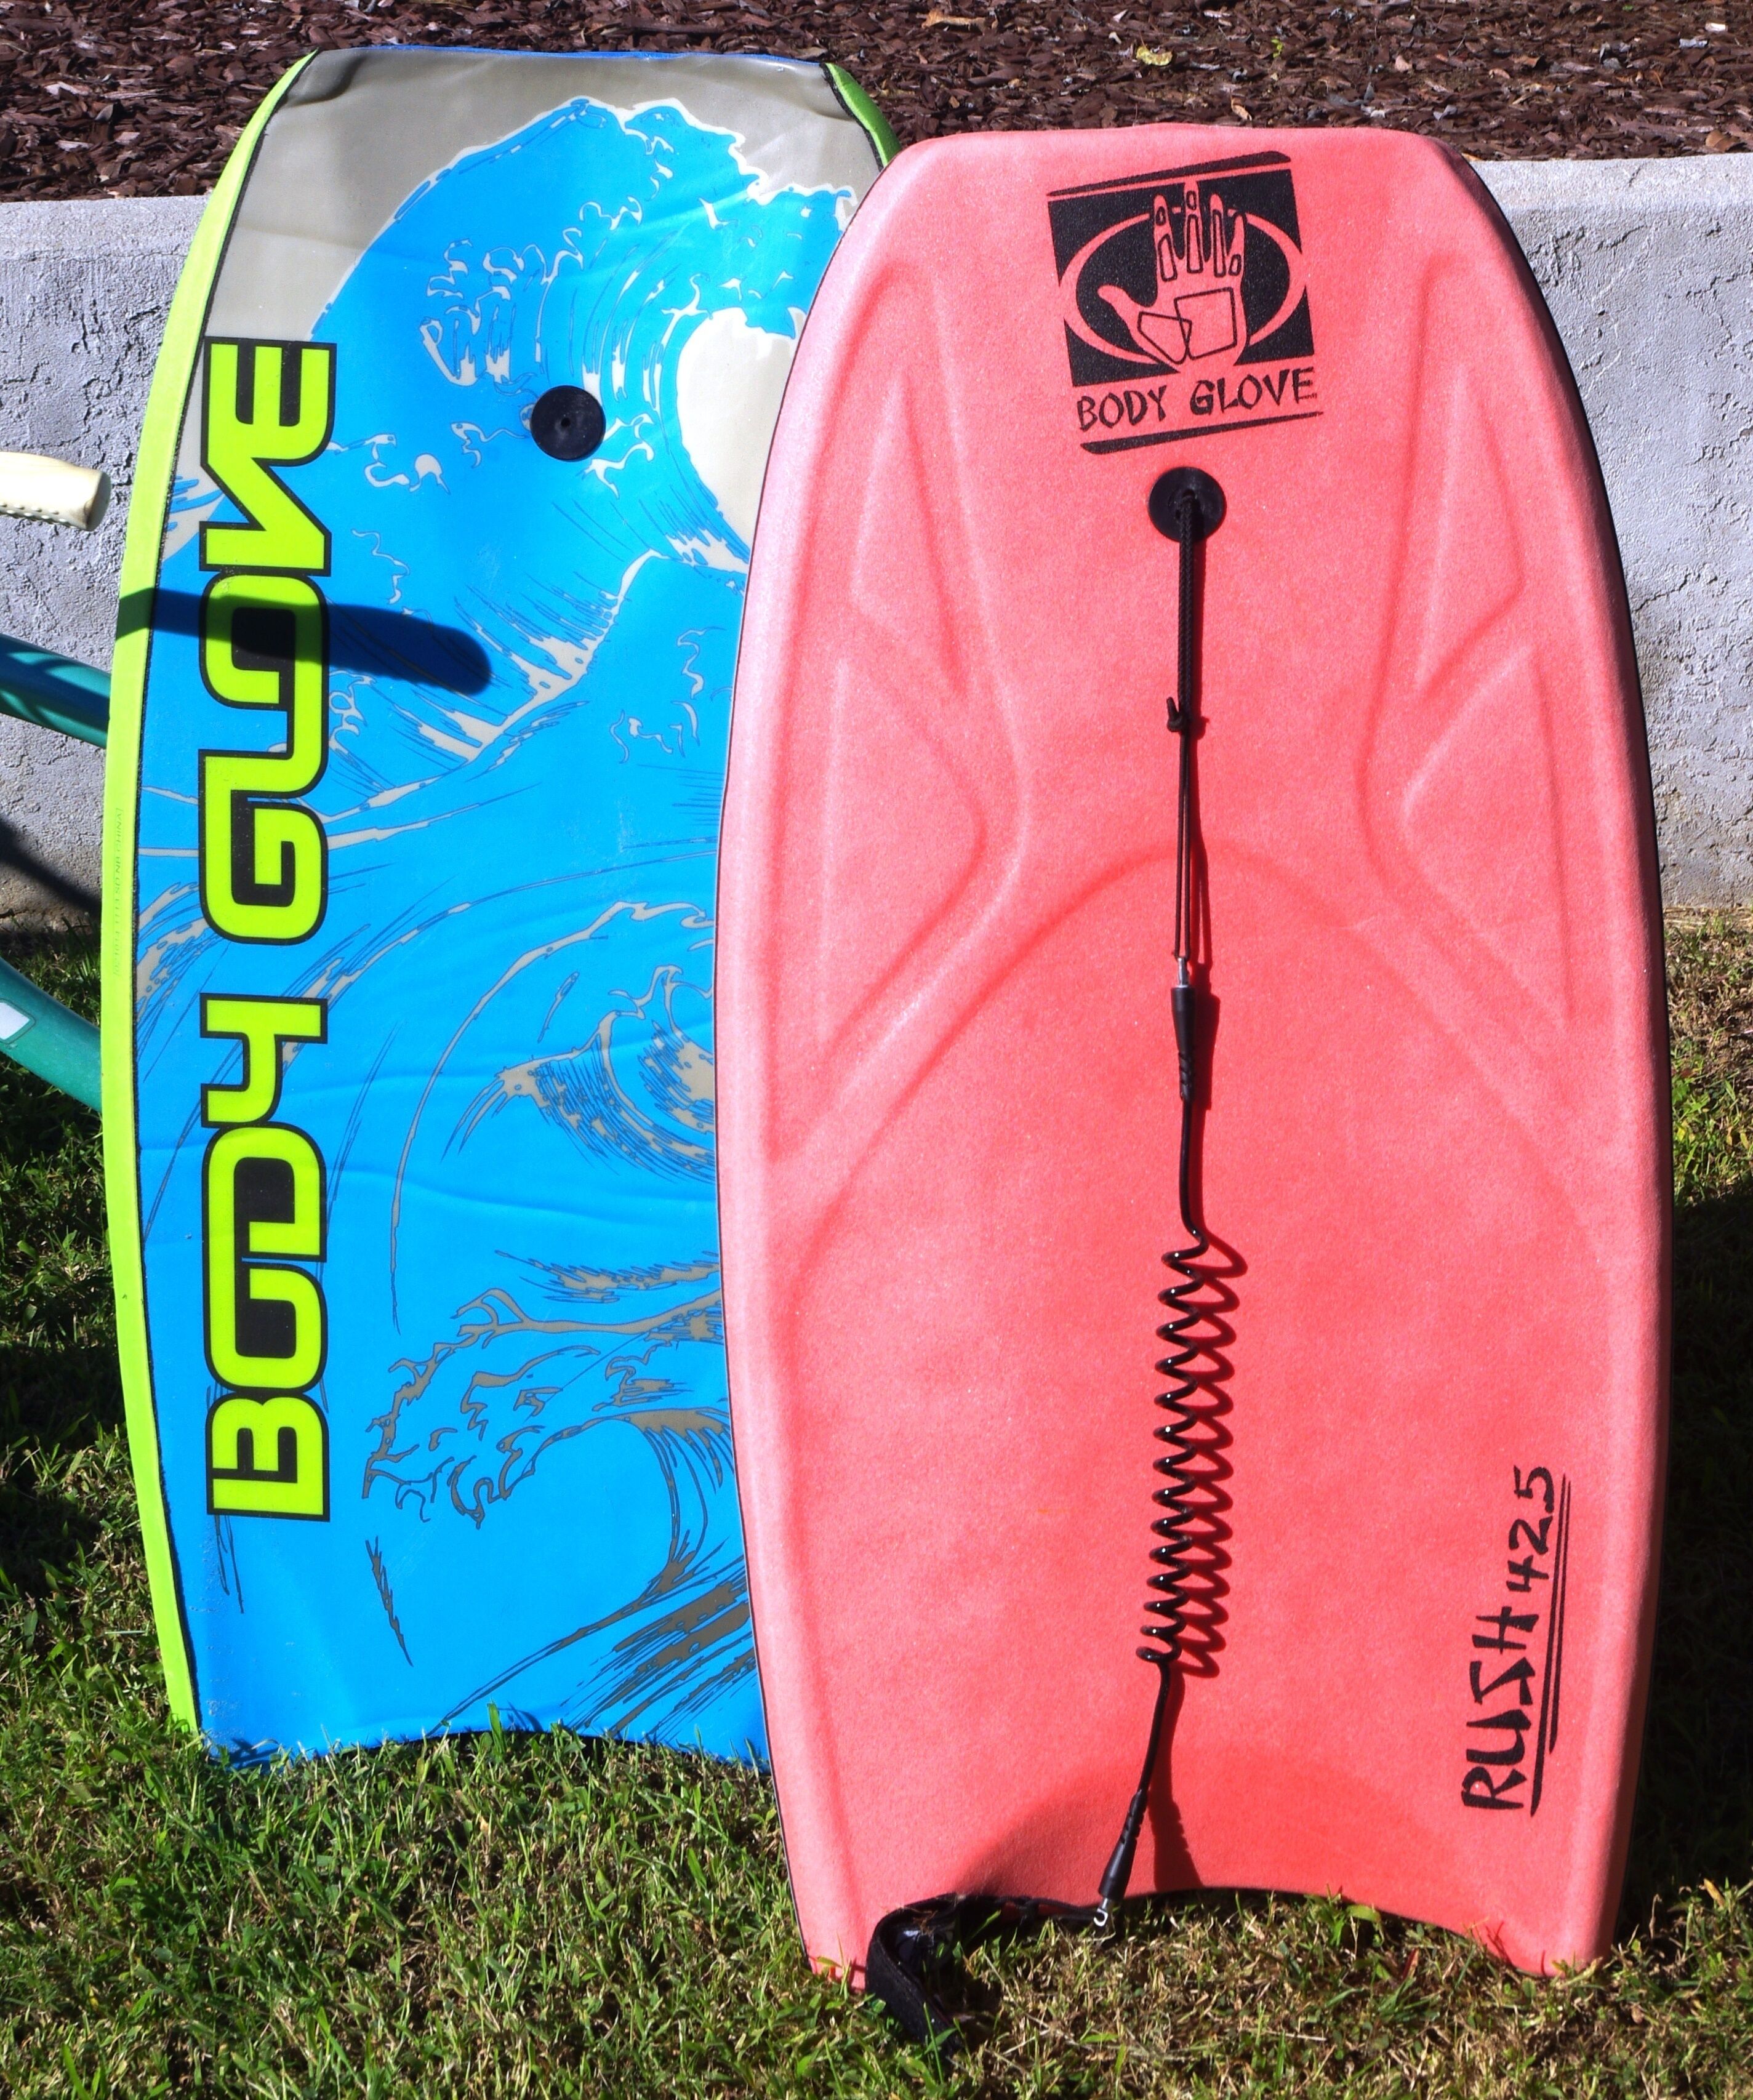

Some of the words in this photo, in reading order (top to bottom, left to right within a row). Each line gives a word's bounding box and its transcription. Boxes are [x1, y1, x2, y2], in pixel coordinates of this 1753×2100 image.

[1077, 385, 1167, 431] BODY
[1190, 366, 1317, 416] GLOVE
[198, 337, 337, 945] GLOVE
[199, 993, 331, 1522] BODY
[1461, 1606, 1539, 1810] RUSH
